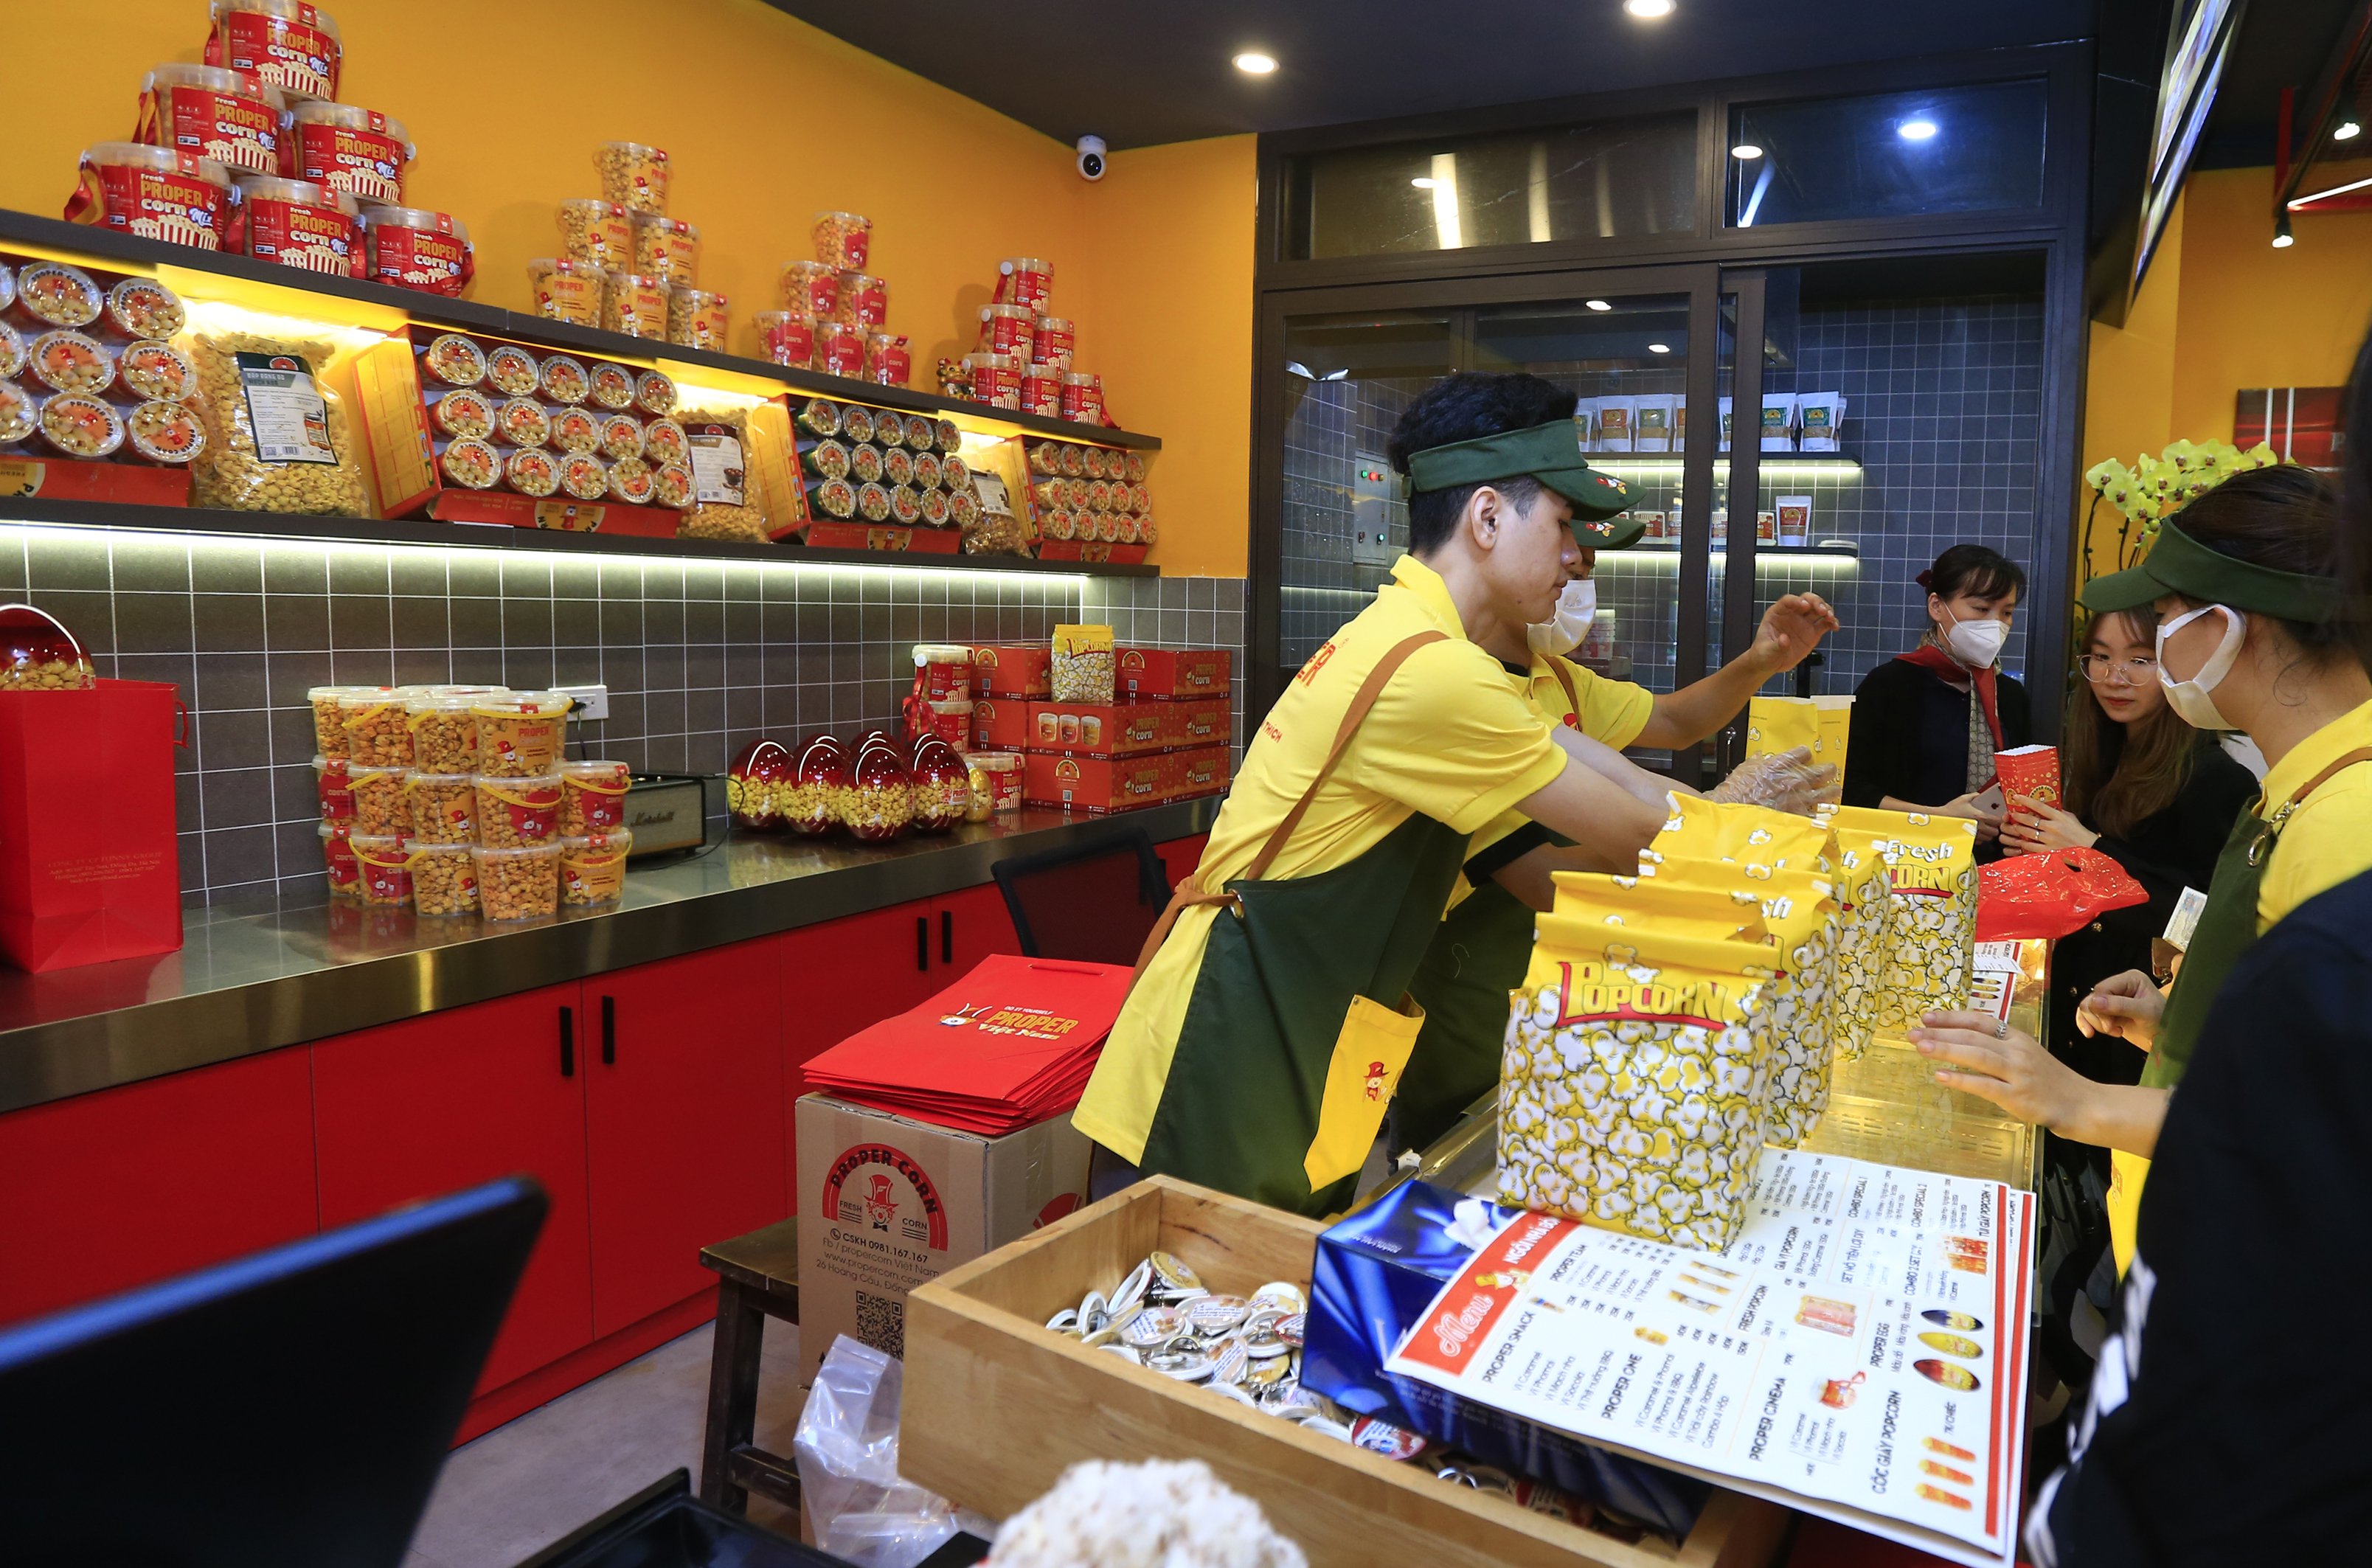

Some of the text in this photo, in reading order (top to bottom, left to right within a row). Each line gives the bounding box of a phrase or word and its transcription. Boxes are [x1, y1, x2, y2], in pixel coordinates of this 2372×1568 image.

[267, 27, 321, 55] PROPER
[266, 44, 308, 64] corn
[214, 103, 268, 131] PROPER
[215, 122, 257, 139] corn
[335, 136, 387, 160] PROPER
[336, 153, 375, 169] corn
[140, 181, 203, 207] PROPER
[140, 198, 187, 216] corn
[289, 214, 341, 237] PROPER
[290, 230, 330, 246] corn
[414, 239, 457, 260] PROPER
[414, 254, 448, 270] corn
[555, 280, 584, 292] PROPER
[41, 339, 94, 359] PROPER CORN
[70, 400, 114, 437] PROPER CORN
[154, 429, 196, 455] PROPER CORN
[1196, 676, 1210, 684] corn
[519, 726, 549, 737] PROPER
[1136, 731, 1153, 740] corn
[1196, 725, 1210, 734] corn
[1134, 784, 1152, 793] corn
[1196, 773, 1210, 783] corn
[1886, 839, 1955, 862] Fresh
[1561, 962, 1727, 1027] POPCORN
[984, 1010, 1079, 1034] PROPER
[1015, 1029, 1061, 1040] Nam
[830, 1149, 939, 1214] PROPER CORN
[1853, 1179, 1867, 1199] SPECIAL
[839, 1200, 862, 1213] FRESH
[1847, 1198, 1862, 1218] COMBO
[1913, 1187, 1927, 1207] SPECIAL
[1980, 1189, 1992, 1215] POPCORN
[902, 1218, 928, 1230] CORN
[1910, 1207, 1924, 1227] COMBO
[842, 1233, 929, 1263] CSKH 0981.167.167
[1780, 1226, 1800, 1253] POPCORN
[816, 1260, 827, 1269] 26
[822, 1238, 833, 1248] Fb
[915, 1263, 940, 1278] Nam
[1774, 1260, 1788, 1269] GIA
[1549, 1257, 1577, 1282] PROPER
[1903, 1272, 1918, 1296] COMBO
[1737, 1285, 1769, 1332] FRESH POPCORN
[1432, 1293, 1495, 1358] Menu
[1480, 1311, 1537, 1383] PROPER SNACK
[1869, 1322, 1890, 1368] PROPER EGG
[1601, 1353, 1643, 1420] PROPER ONE
[1749, 1376, 1786, 1462] PROPER CINEMA
[1881, 1390, 1902, 1441] POPCORN
